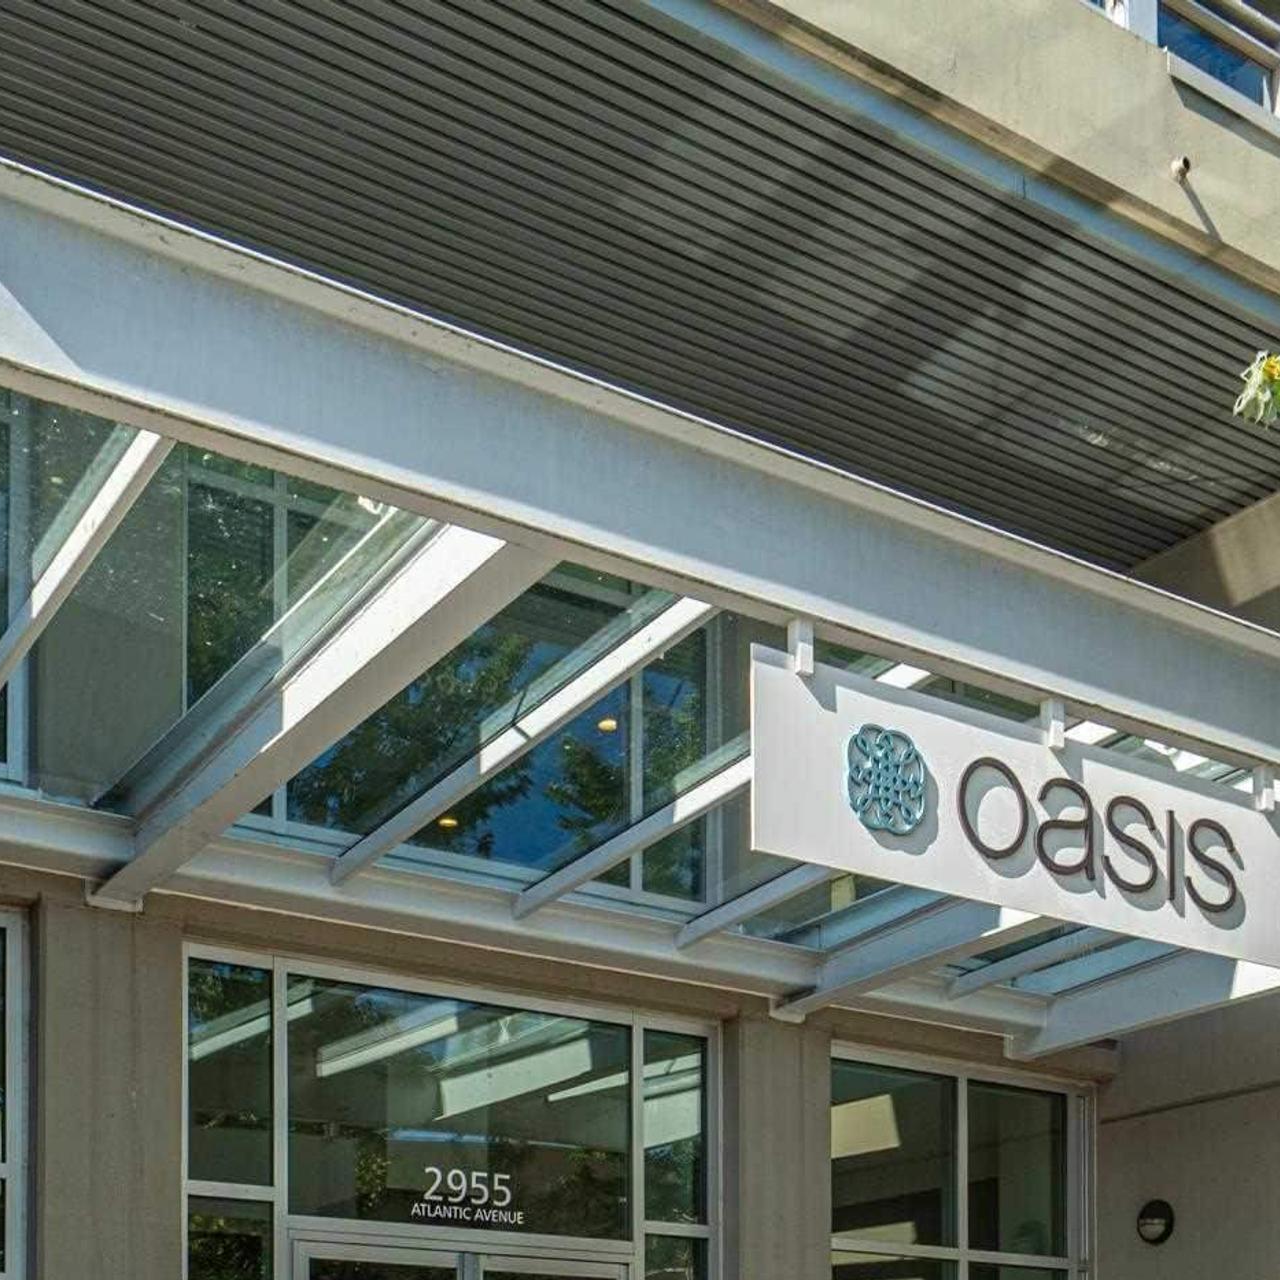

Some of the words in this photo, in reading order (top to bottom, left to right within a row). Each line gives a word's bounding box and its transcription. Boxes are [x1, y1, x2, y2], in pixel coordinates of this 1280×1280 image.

[423, 1166, 512, 1207] 2955
[410, 1202, 472, 1221] ATLANTIC
[473, 1208, 525, 1225] AVENUE
